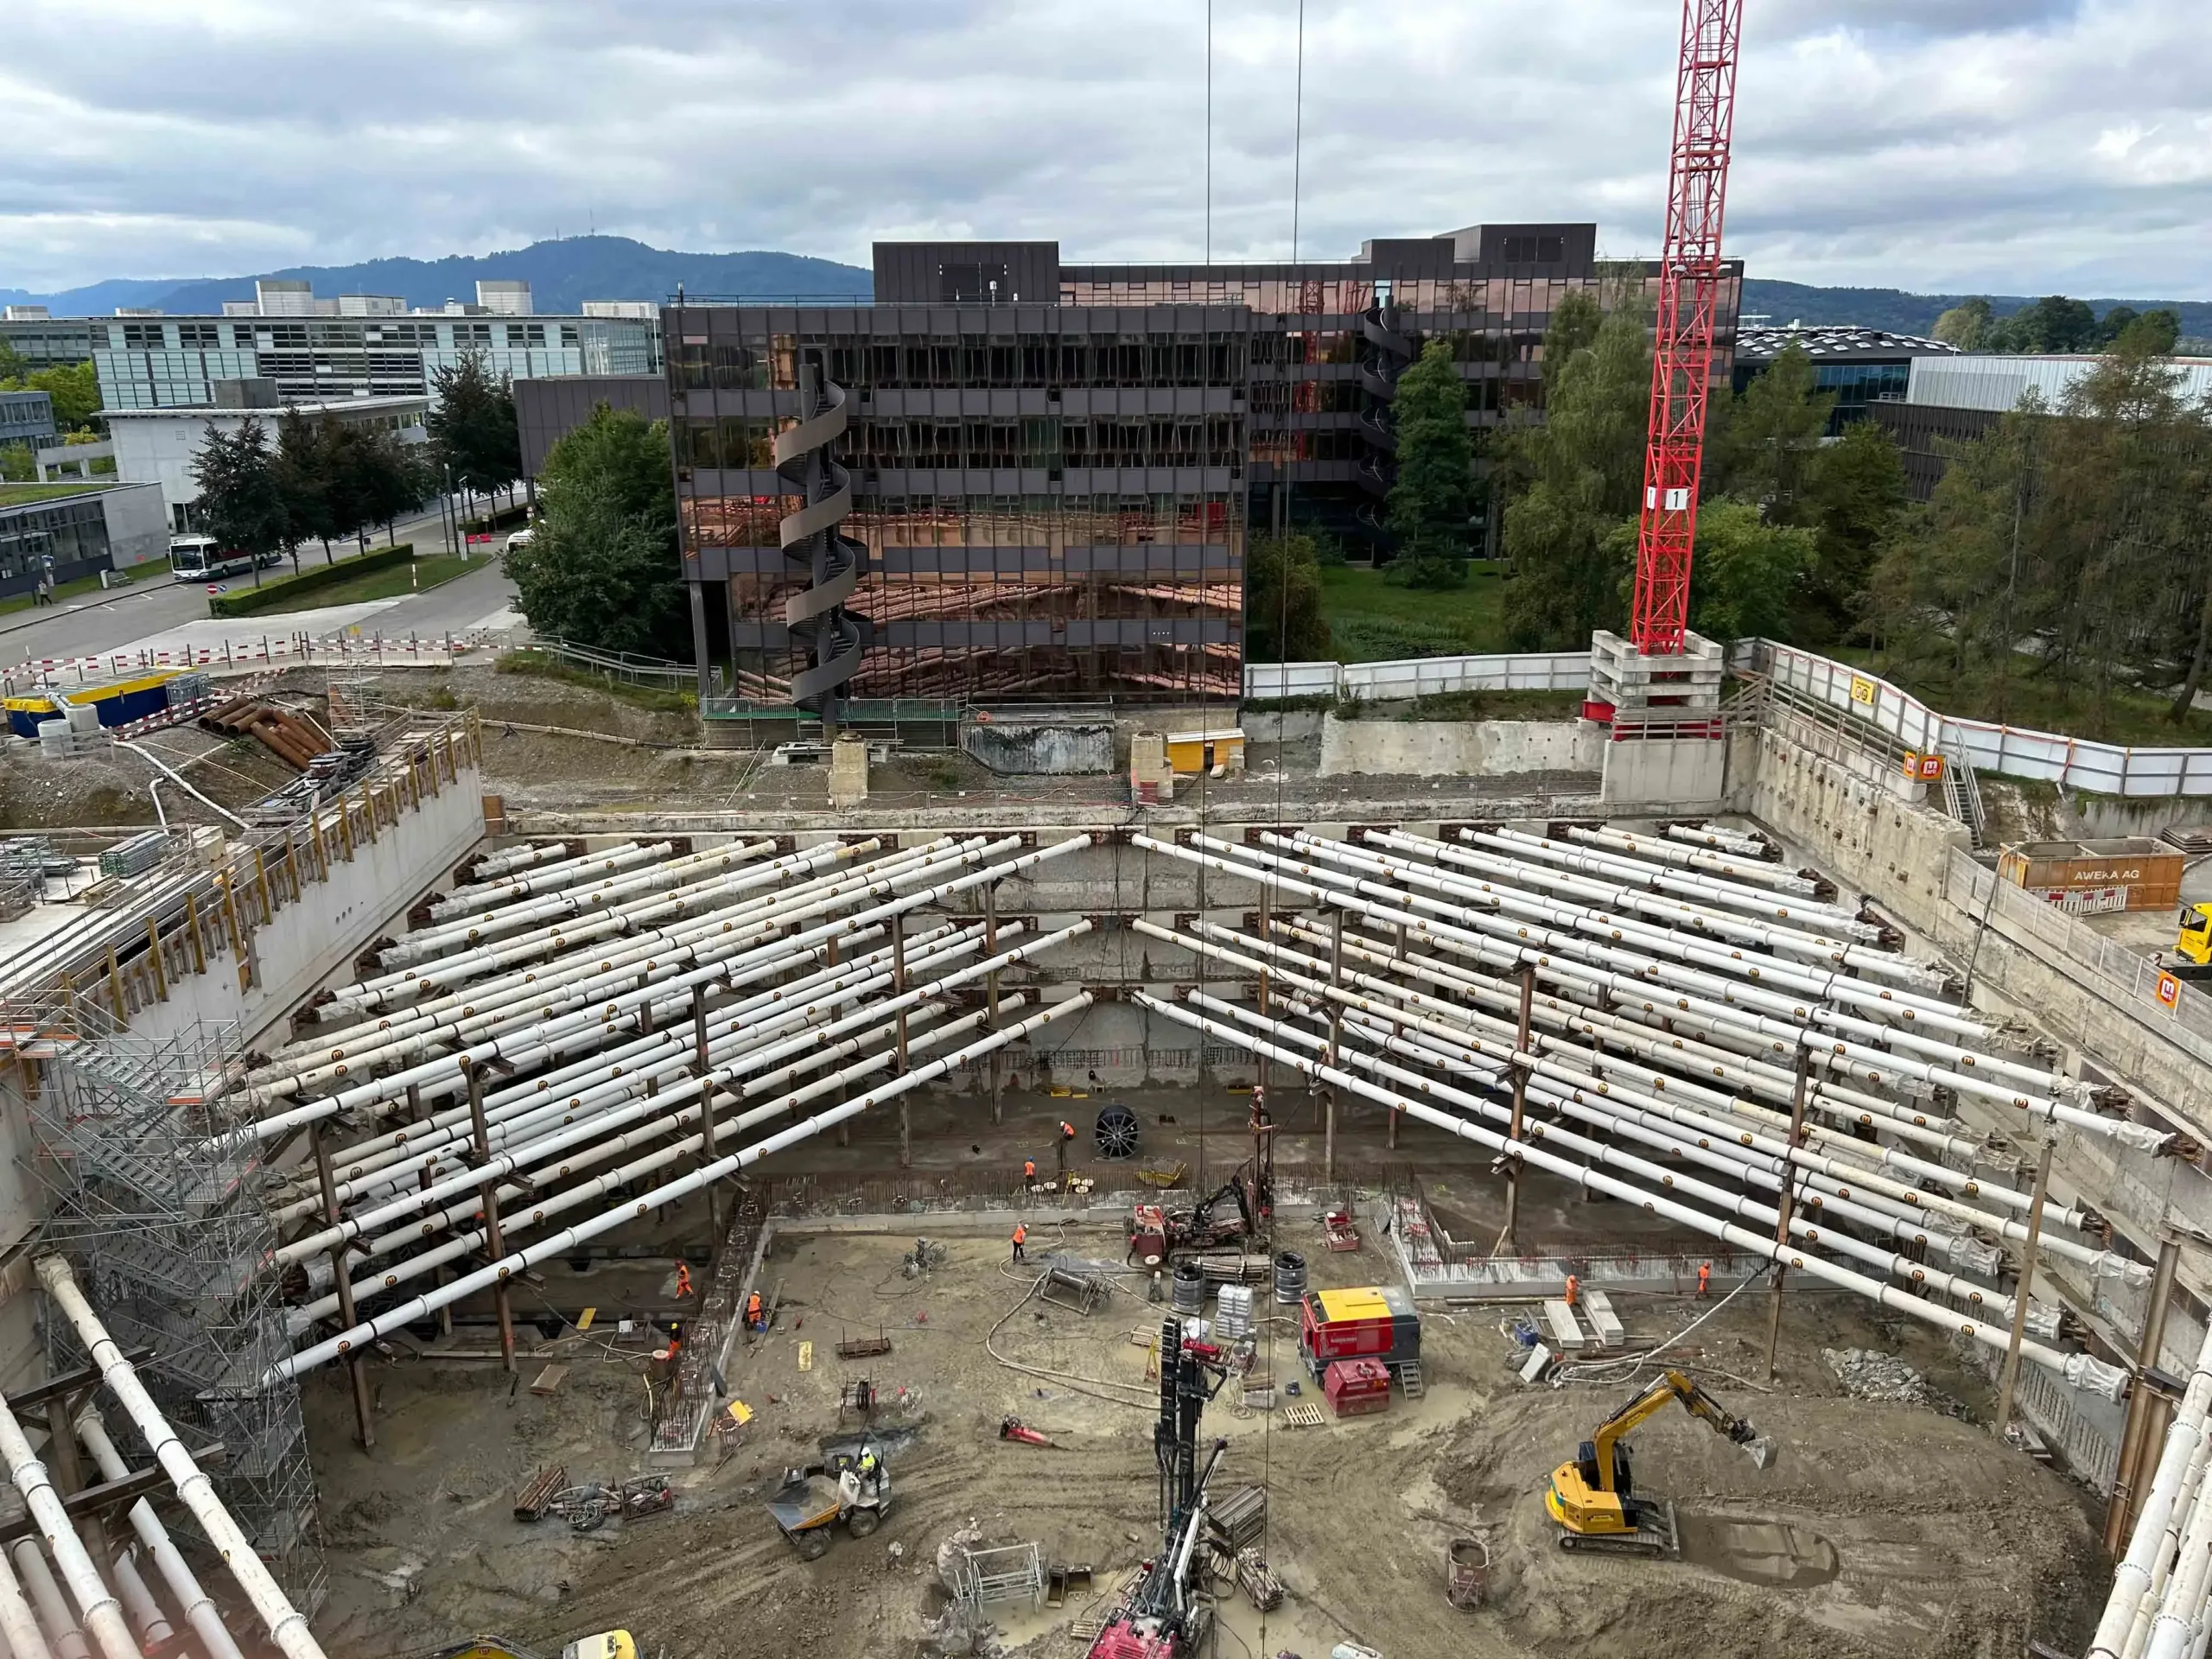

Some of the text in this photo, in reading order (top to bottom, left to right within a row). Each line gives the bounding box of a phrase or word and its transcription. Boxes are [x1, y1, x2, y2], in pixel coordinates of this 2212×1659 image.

[1674, 491, 1679, 508] 1
[2074, 869, 2139, 880] AWEKA AG
